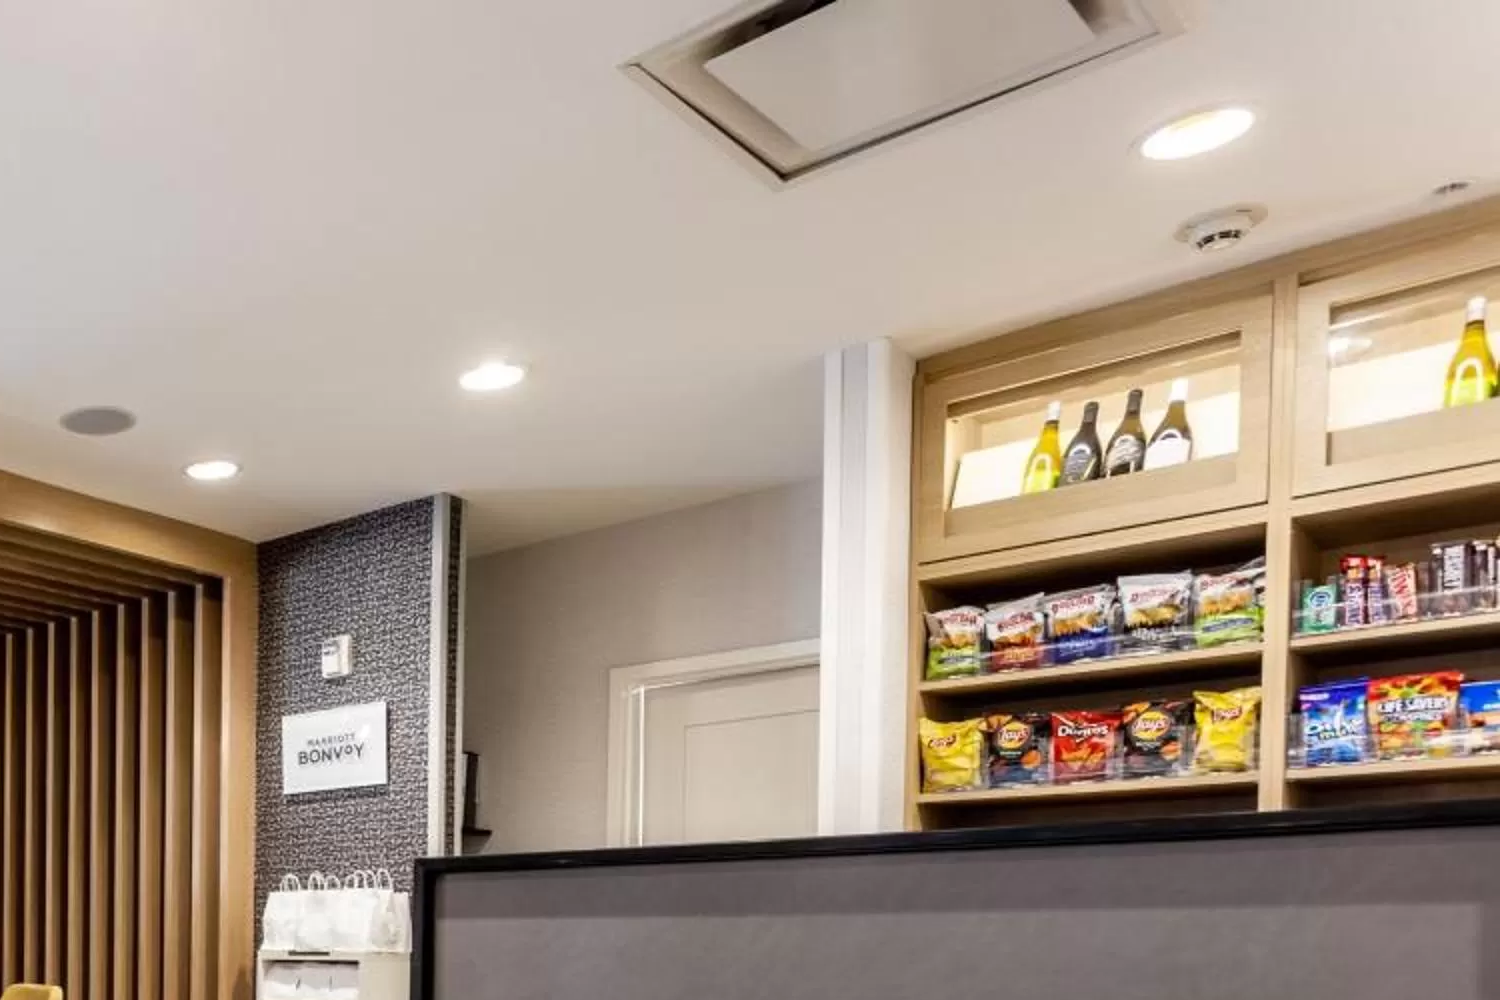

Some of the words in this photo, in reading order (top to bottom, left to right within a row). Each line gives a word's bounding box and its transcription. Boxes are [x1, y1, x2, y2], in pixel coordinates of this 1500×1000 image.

[1057, 723, 1109, 738] Doritos
[307, 733, 356, 747] MARRIOTT
[298, 742, 364, 765] BONVOY
